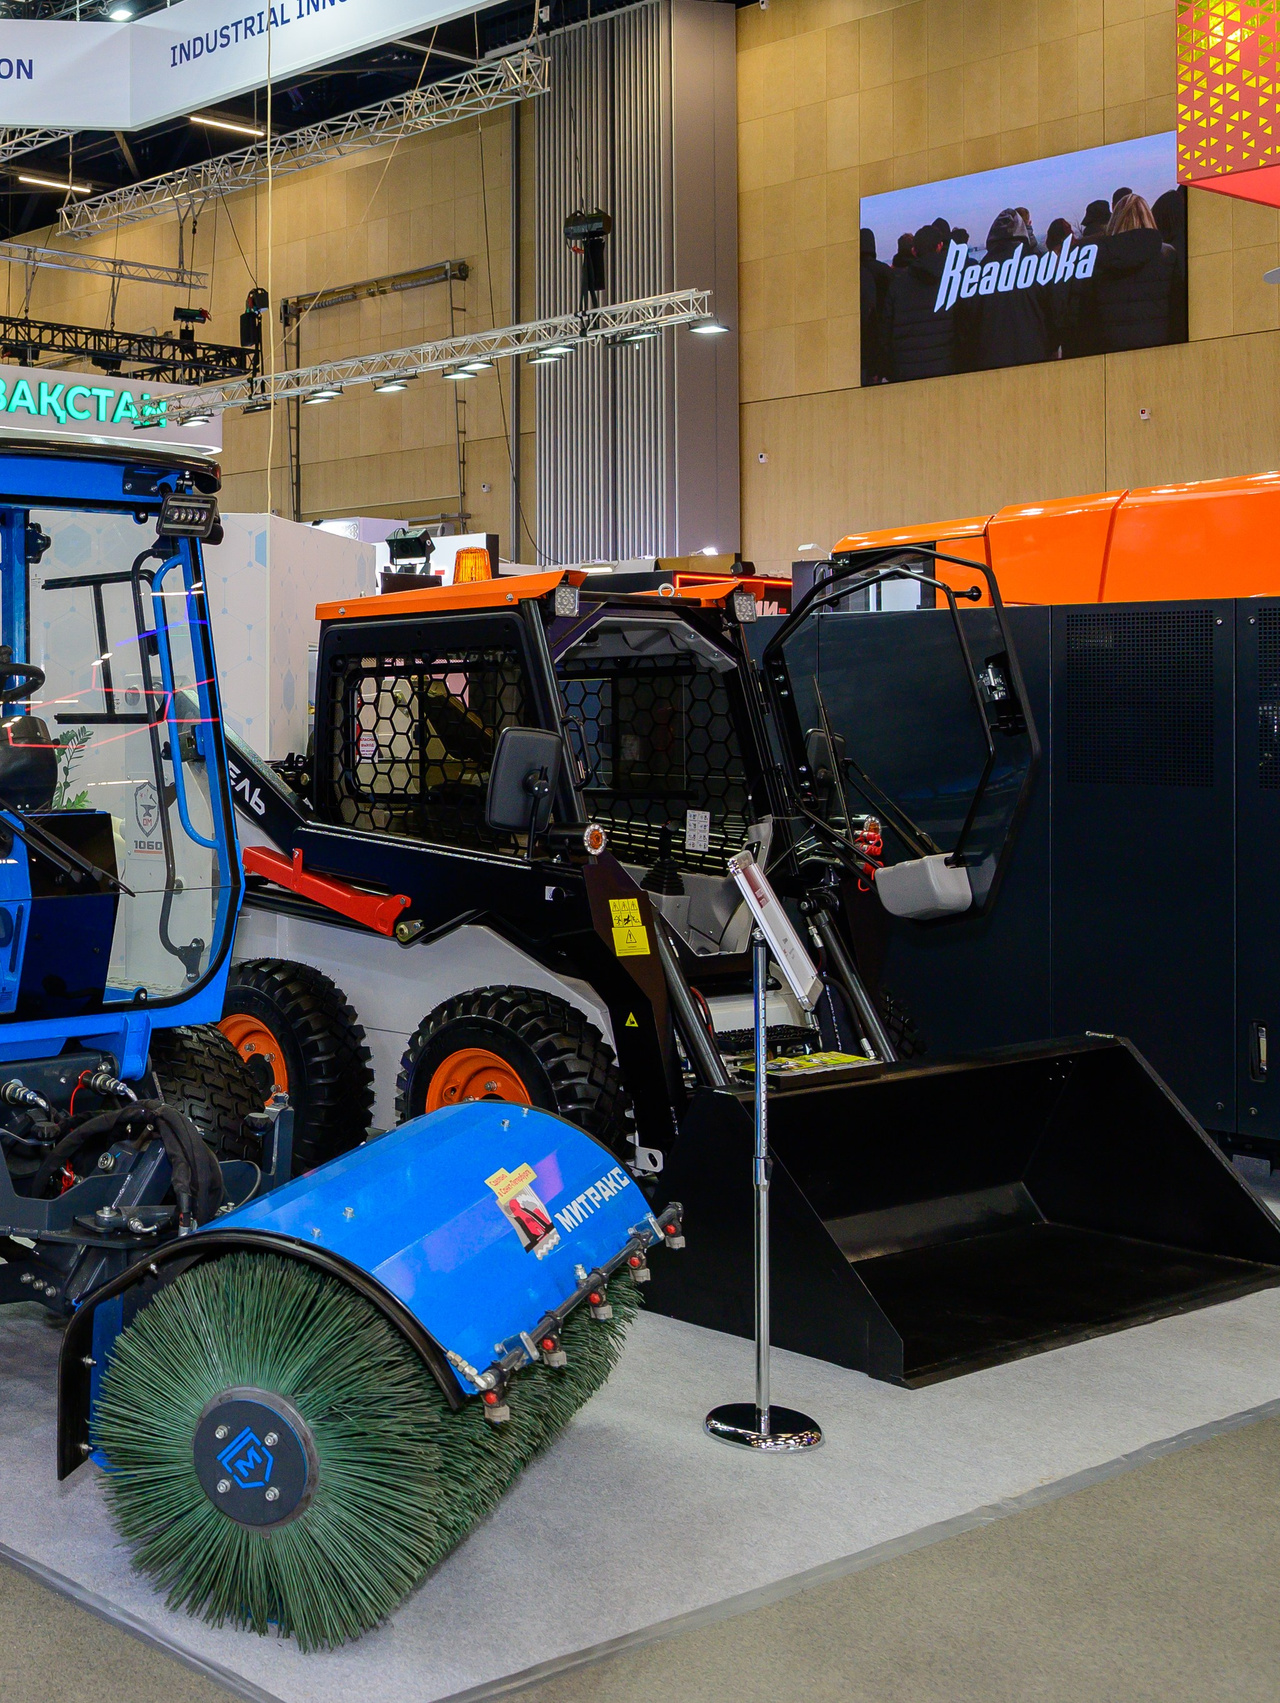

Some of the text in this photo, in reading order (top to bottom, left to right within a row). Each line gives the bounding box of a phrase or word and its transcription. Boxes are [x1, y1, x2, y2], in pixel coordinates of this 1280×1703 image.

[170, 2, 291, 68] INDUSTRIAL
[933, 232, 1099, 313] Readovka
[133, 839, 163, 851] 1060
[553, 1166, 631, 1234] МИТРАКС
